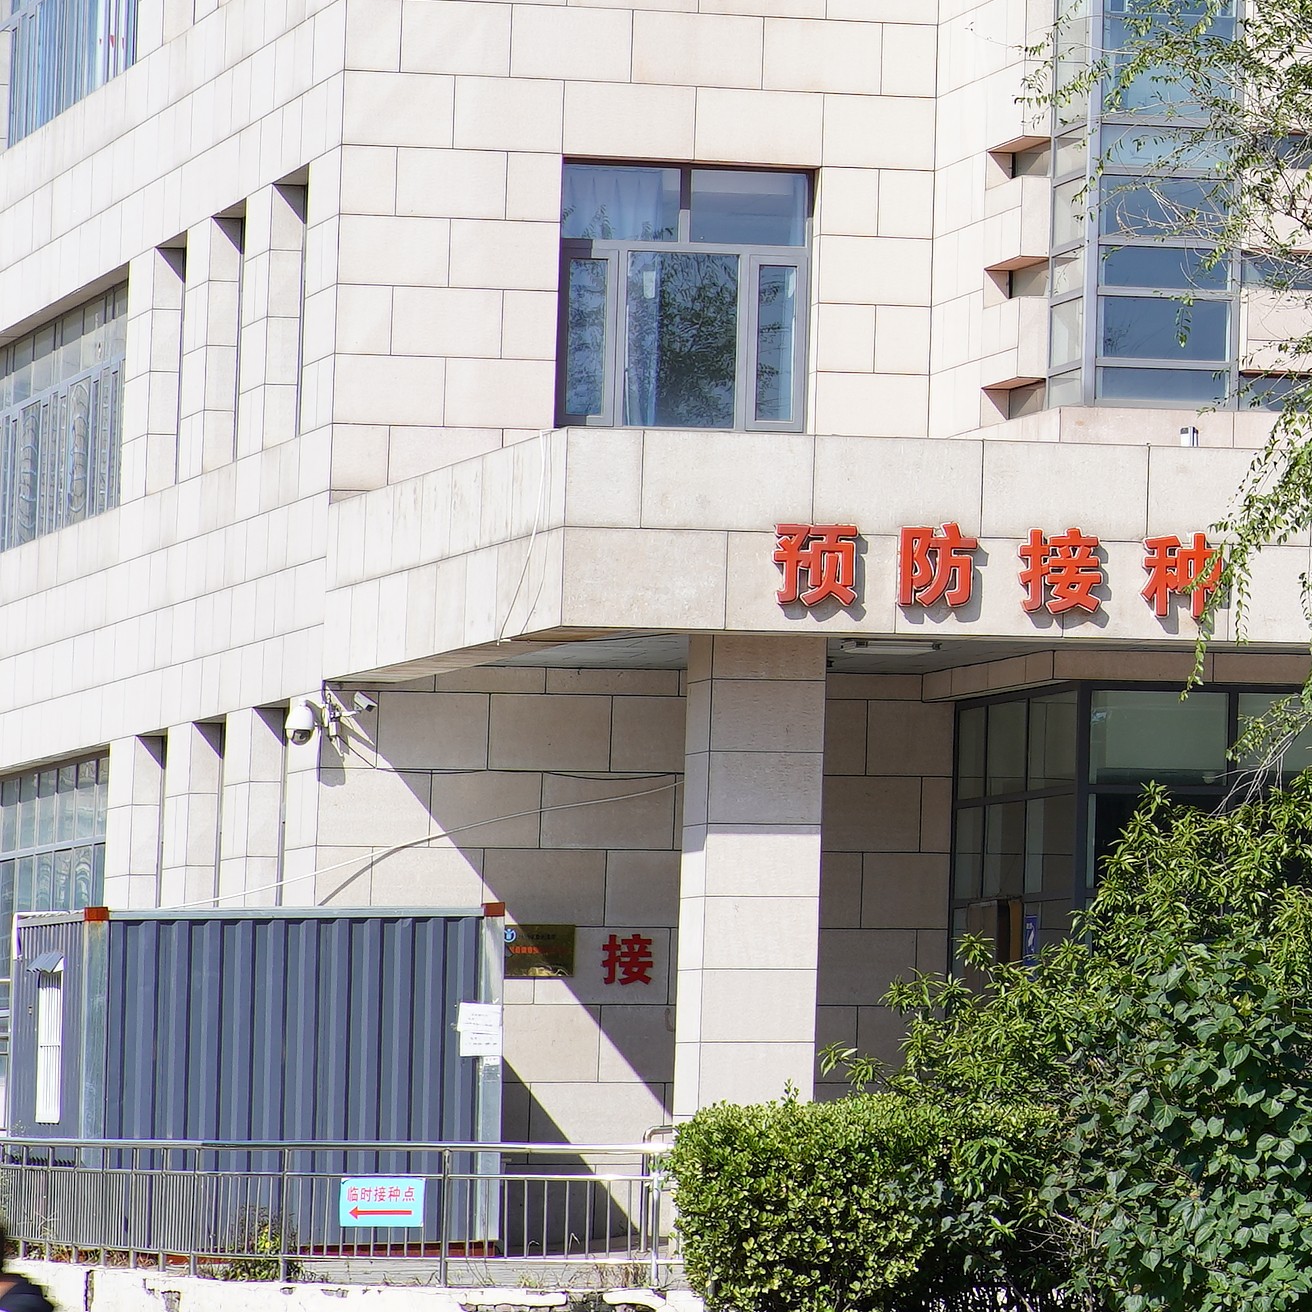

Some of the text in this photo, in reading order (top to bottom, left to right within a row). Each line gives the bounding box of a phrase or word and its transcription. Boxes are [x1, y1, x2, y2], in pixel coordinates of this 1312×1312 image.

[774, 521, 1223, 619] 预防接种
[602, 933, 654, 986] 接
[347, 1186, 416, 1203] 临时接种点
